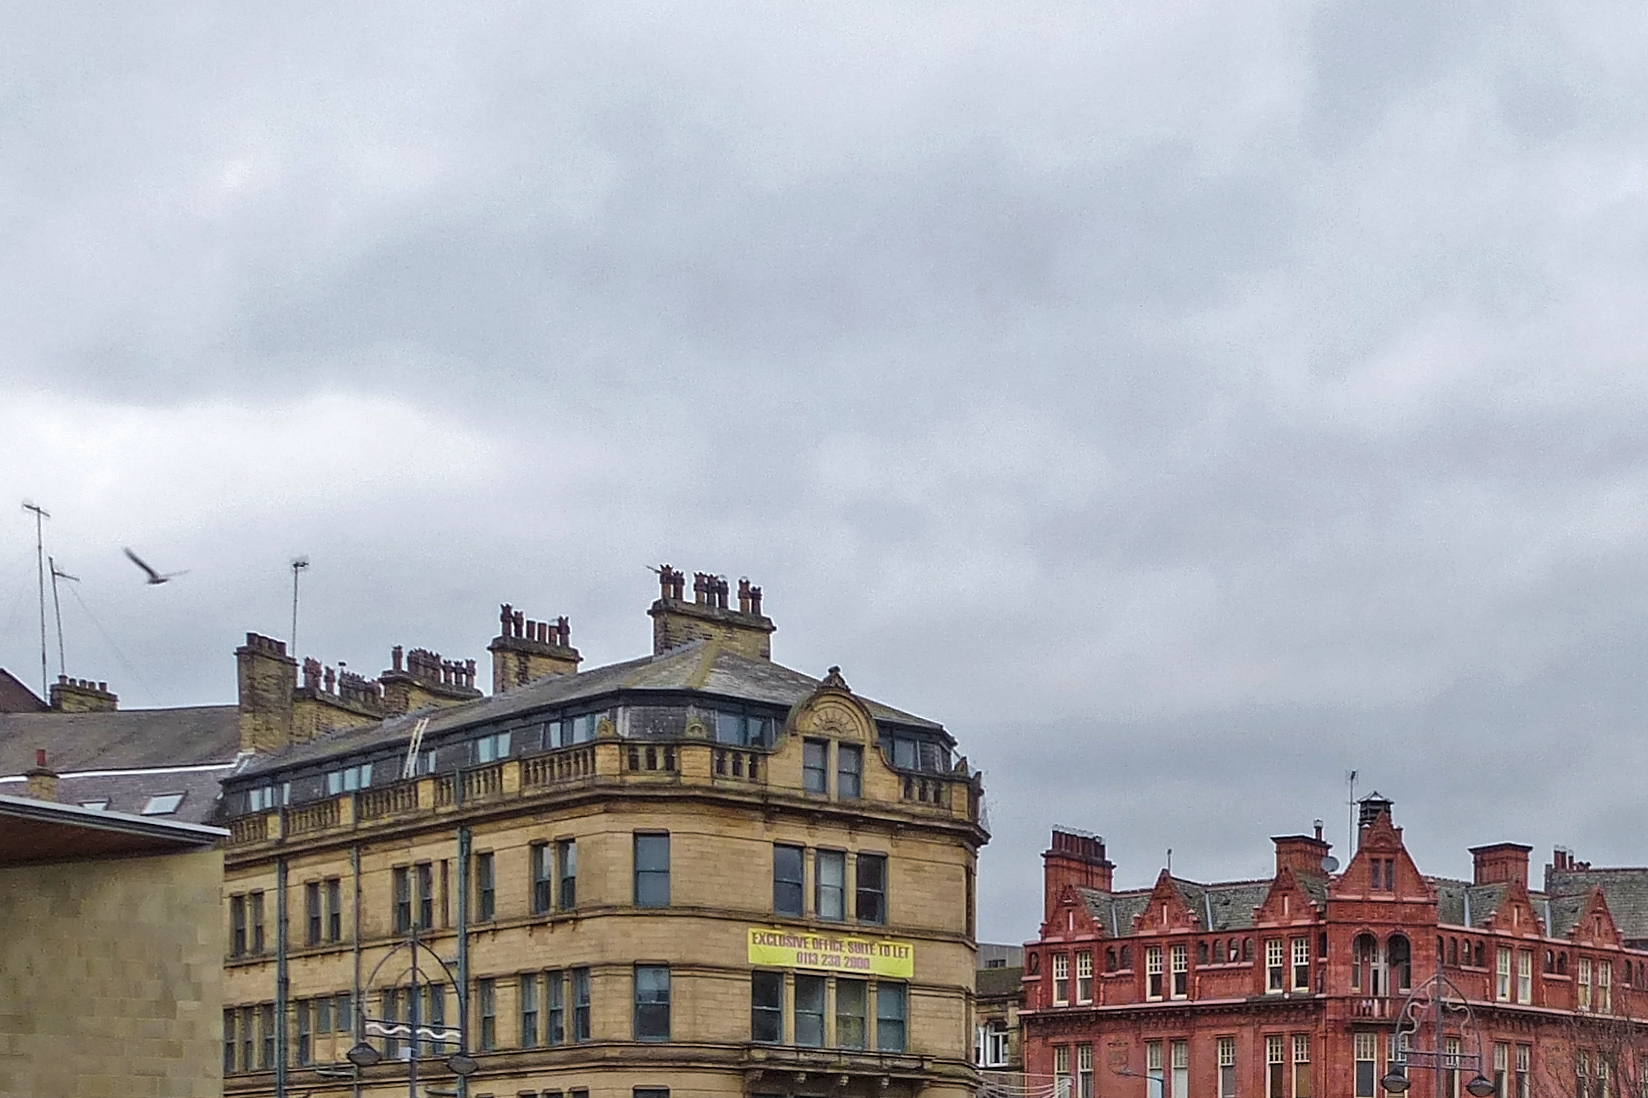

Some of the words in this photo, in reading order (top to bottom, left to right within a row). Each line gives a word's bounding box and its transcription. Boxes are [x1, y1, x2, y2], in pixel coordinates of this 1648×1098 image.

[752, 932, 809, 949] EXCLUSIVE
[812, 938, 845, 952] OFFICE
[848, 941, 876, 955] SUITE
[878, 944, 889, 957] TO
[892, 945, 909, 958] LET
